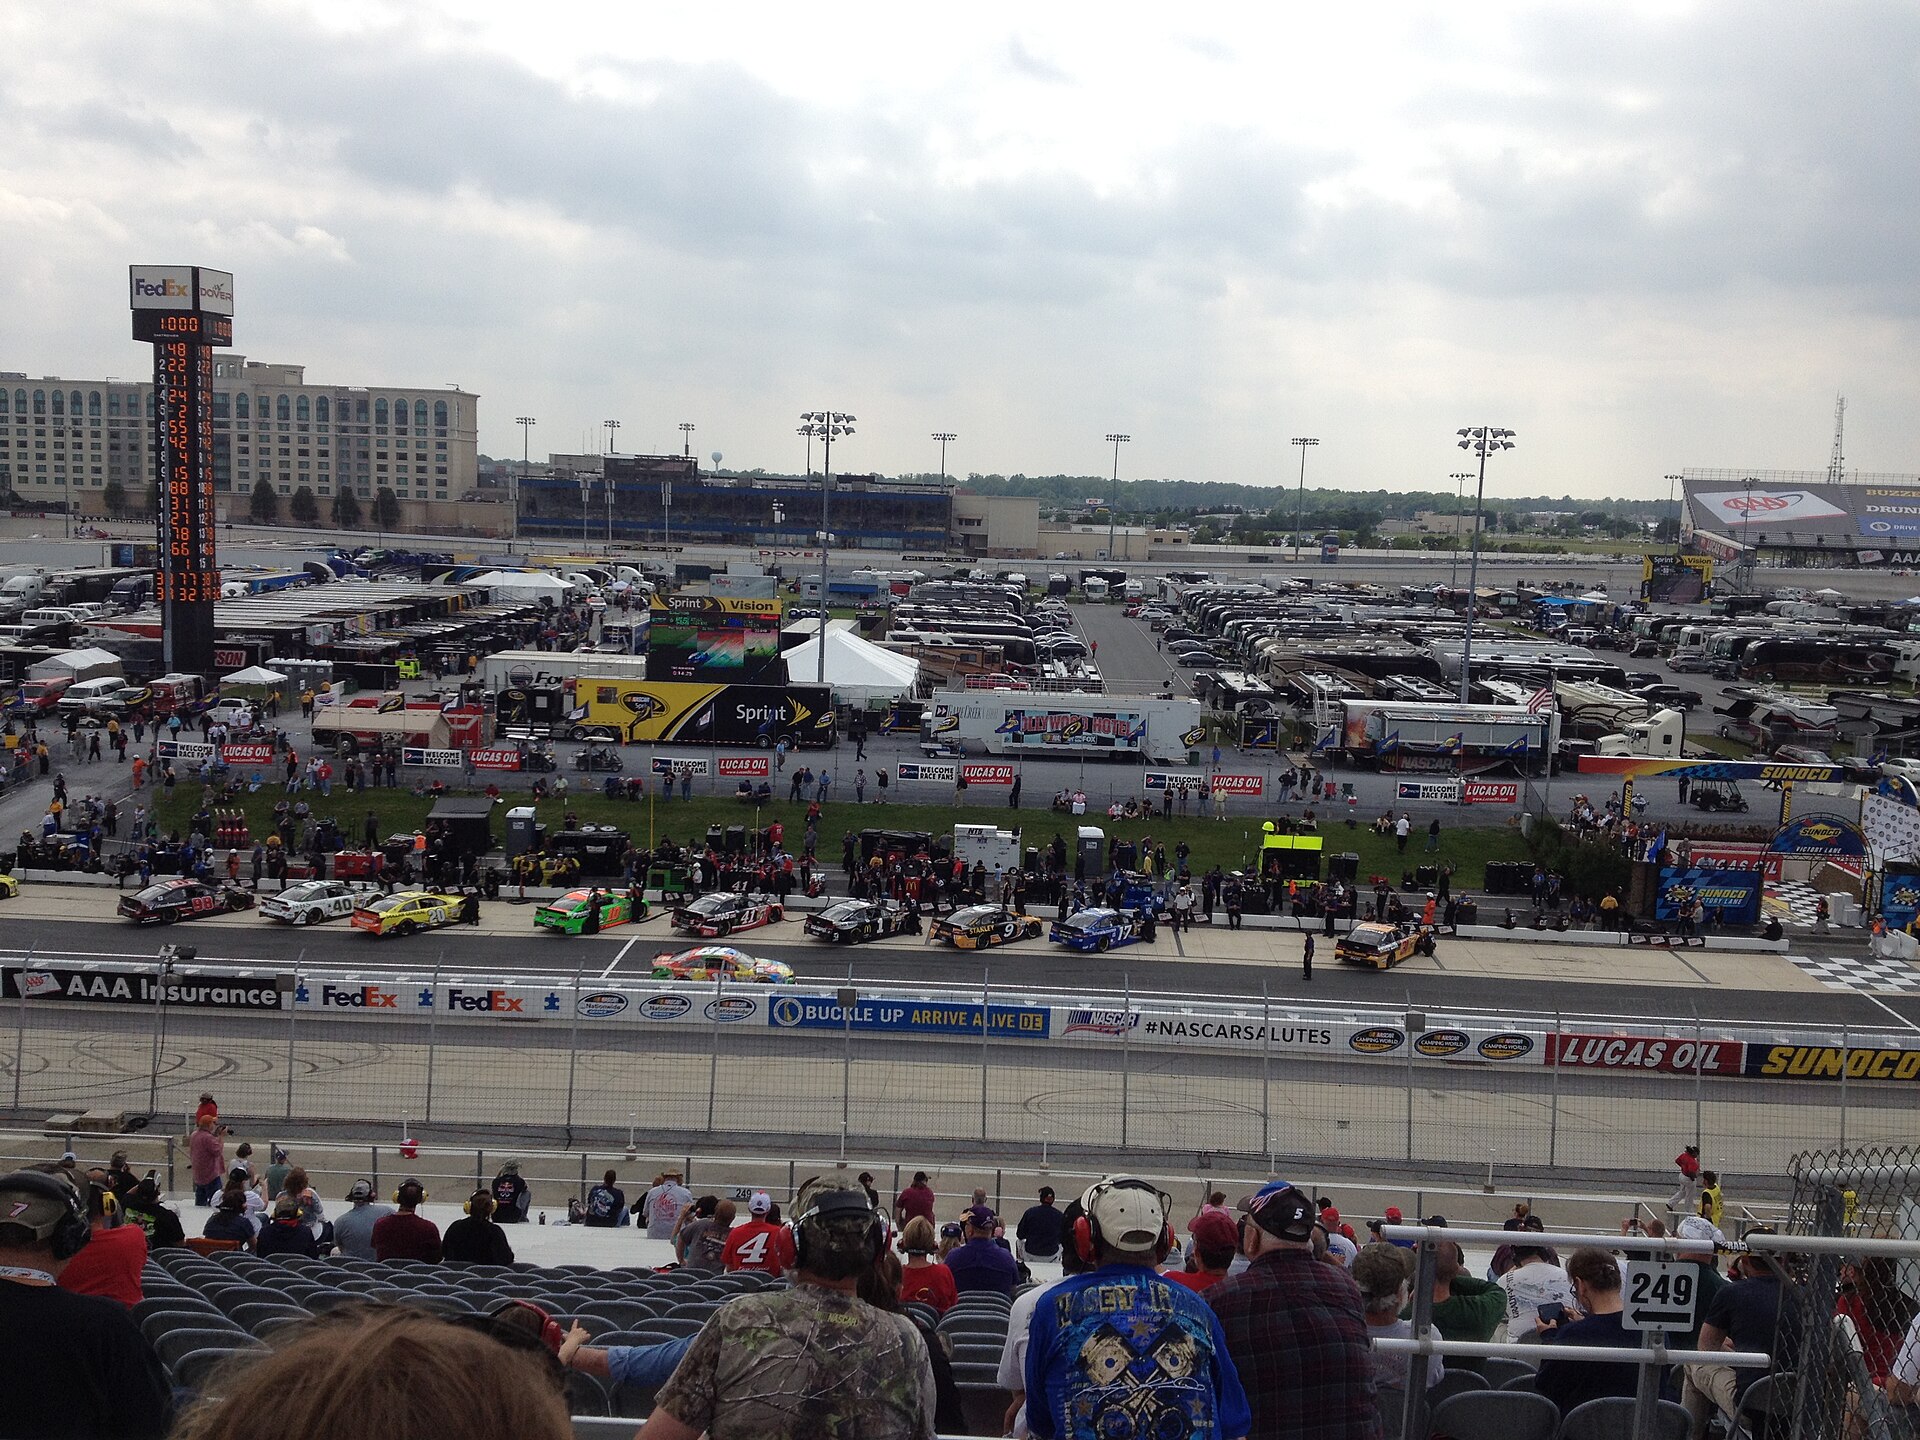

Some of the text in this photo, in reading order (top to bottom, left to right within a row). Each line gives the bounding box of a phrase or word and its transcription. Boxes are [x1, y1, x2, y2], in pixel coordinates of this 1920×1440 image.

[135, 278, 188, 297] FedEx
[200, 287, 233, 301] DOVER
[160, 343, 186, 356] 1 48
[159, 358, 186, 372] 2 22
[160, 374, 186, 387] 3 11
[160, 389, 187, 403] 4 24
[160, 405, 187, 419] 5 2
[160, 420, 187, 434] 6 55
[160, 436, 187, 449] 7 42
[161, 451, 188, 463] 8 4
[161, 466, 188, 480] 9 15
[170, 482, 188, 495] 88
[172, 497, 189, 510] 31
[1727, 498, 1787, 511] AAA
[1866, 505, 1920, 514] DRUN
[171, 512, 189, 525] 27
[172, 528, 189, 540] 78
[172, 542, 190, 555] 66
[186, 559, 190, 570] 1
[1654, 556, 1674, 564] Sprint
[179, 572, 197, 585] 77
[180, 588, 197, 601] 32
[669, 598, 774, 611] Sprint Vision
[214, 652, 243, 666] SON
[180, 744, 214, 753] WELCOME
[224, 747, 270, 757] LUCAS OIL
[425, 751, 460, 759] WELCOME
[471, 752, 518, 763] LUCAS OIL
[1400, 758, 1453, 769] NASCAR
[720, 760, 767, 769] LUCAS OIL
[965, 768, 1011, 778] LUCAS OIL
[1760, 766, 1833, 781] SUNOCO
[1168, 776, 1202, 784] WELCOME
[1214, 777, 1261, 788] LUCAS OIL
[1467, 786, 1515, 796] LUCAS OIL
[1623, 784, 1633, 818] SUNOCO
[1782, 791, 1792, 823] SUNOCO
[1801, 828, 1840, 836] SUNOCO
[1752, 860, 1778, 875] OIL
[732, 881, 748, 891] 41
[1698, 888, 1747, 899] SUNOCO
[192, 896, 214, 912] 98
[334, 899, 353, 912] 40
[428, 908, 446, 924] 20
[608, 906, 621, 922] 10
[740, 910, 756, 924] 41
[877, 918, 884, 934] 1
[969, 925, 995, 936] STANLEY
[1003, 924, 1015, 938] 9
[1118, 925, 1133, 941] 17
[67, 976, 277, 1005] AAA Insurance
[323, 985, 398, 1009] FedEx
[449, 989, 524, 1013] FedEx
[586, 1003, 621, 1011] Nationwide
[650, 1005, 685, 1013] Nationwide
[806, 1005, 1041, 1030] BUCKLE UP ARRIVE ALIVE DE
[1090, 1012, 1137, 1027] NASCAR
[1146, 1022, 1332, 1045] #NASCARSALUTES
[1562, 1038, 1721, 1070] LUCAS OIL
[1762, 1046, 1920, 1078] SUNOCO
[736, 1188, 752, 1198] 249
[9, 1202, 30, 1218] 7
[1294, 1208, 1304, 1220] 5
[737, 1232, 769, 1263] 4
[1630, 1272, 1693, 1306] 249
[828, 1313, 859, 1328] NASCAR
